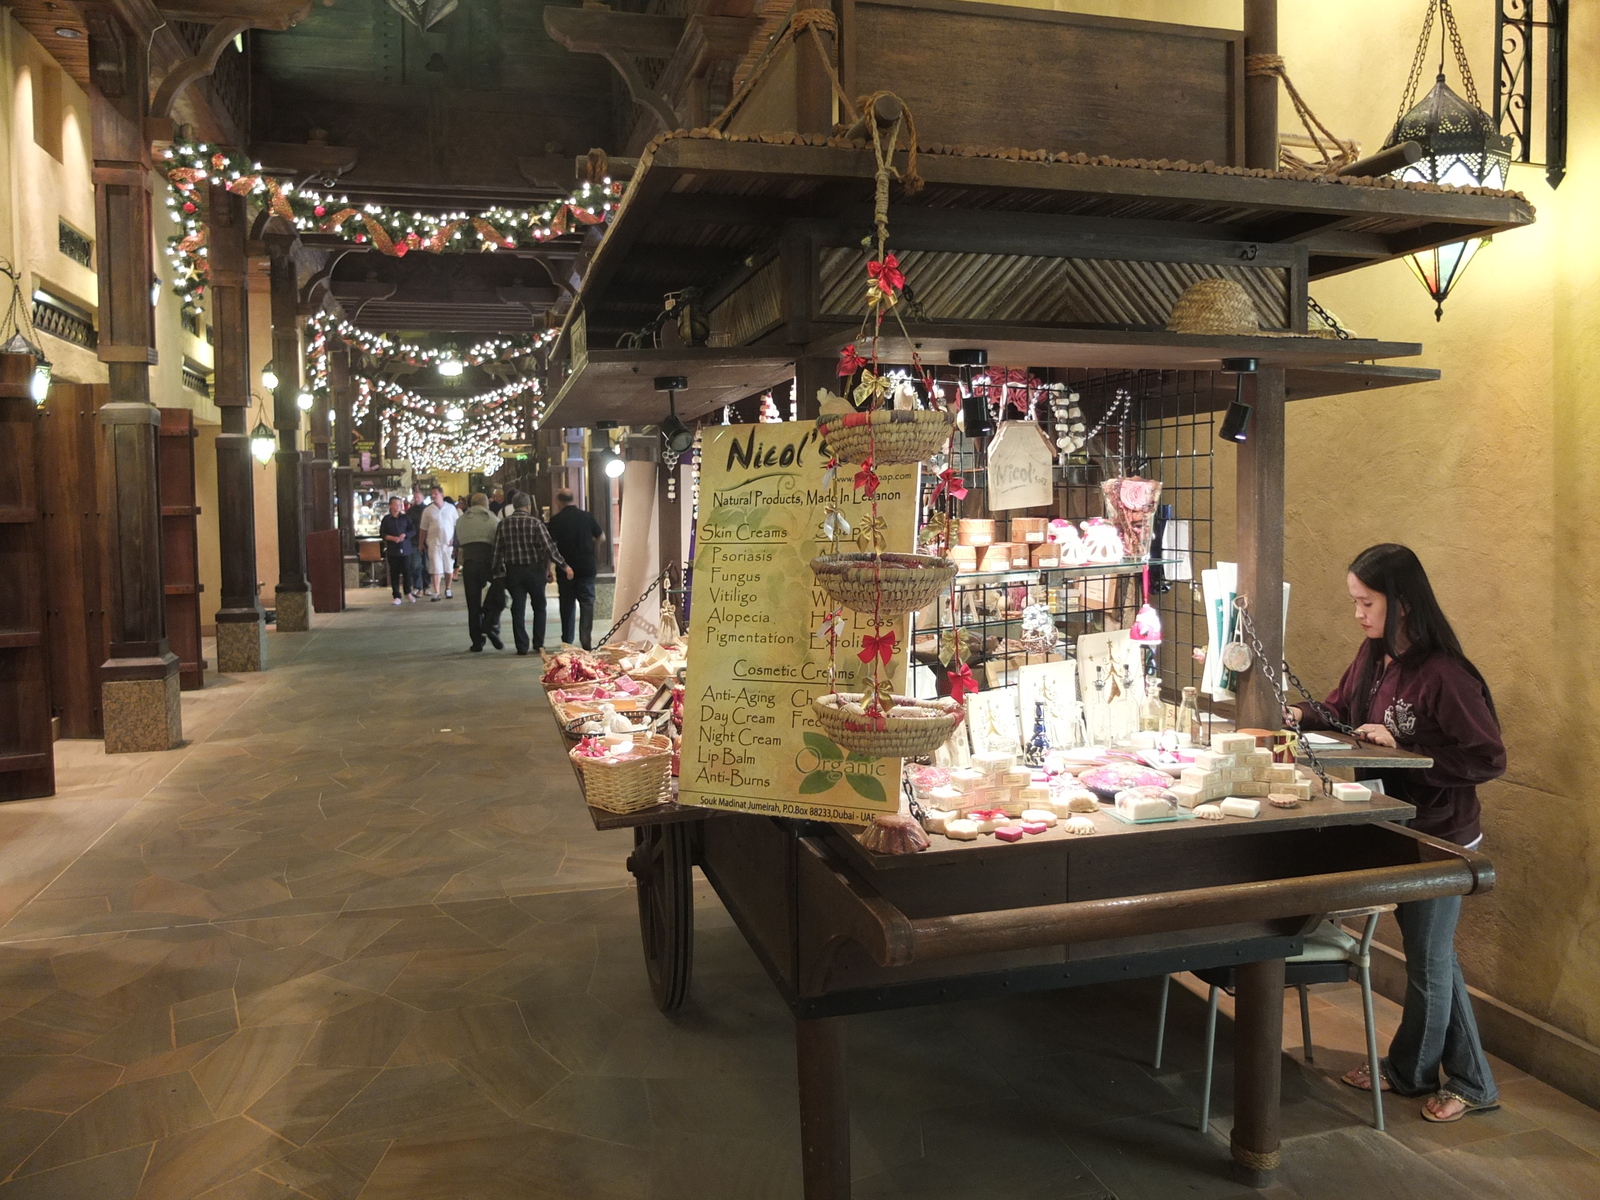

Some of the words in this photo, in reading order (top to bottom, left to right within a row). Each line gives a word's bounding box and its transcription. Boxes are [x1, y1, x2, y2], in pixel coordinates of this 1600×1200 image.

[713, 491, 752, 508] Natural
[755, 490, 803, 507] Products,
[840, 488, 850, 504] In
[701, 524, 732, 540] Skin
[736, 524, 788, 541] Creams
[711, 547, 773, 563] Psoriasis
[711, 567, 761, 585] Fungus
[709, 587, 758, 606] Vitiligo
[707, 607, 770, 627] Alopecia
[706, 627, 794, 647] Pigmentation
[733, 659, 797, 678] Cosmetic
[701, 685, 776, 708] Anti-Aging
[700, 705, 728, 726] Day
[731, 706, 775, 724] Cream
[698, 726, 735, 746] Night
[738, 728, 781, 746] Cream
[698, 749, 719, 769] Lip
[722, 748, 756, 765] Balm
[795, 746, 887, 780] Organic
[695, 767, 770, 788] Anti-Burns
[700, 796, 717, 807] Souk
[718, 797, 746, 810] Madinat
[747, 801, 782, 816] Jumeirah,
